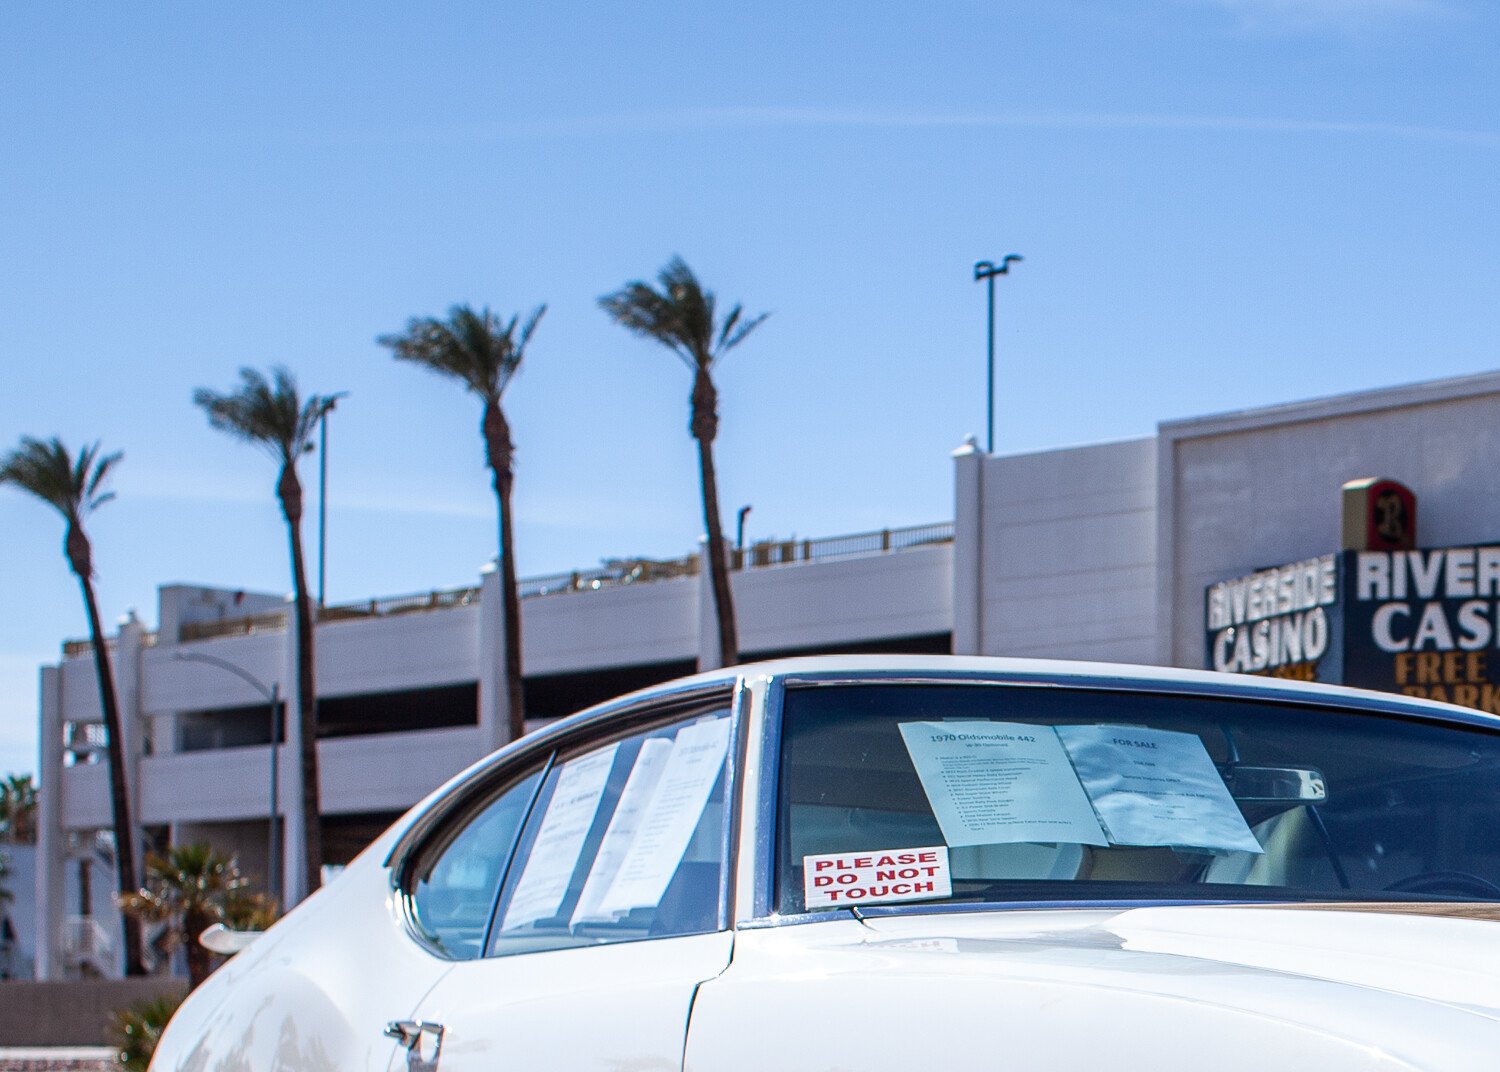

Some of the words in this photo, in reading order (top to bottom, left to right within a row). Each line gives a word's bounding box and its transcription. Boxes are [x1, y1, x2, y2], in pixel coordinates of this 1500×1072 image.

[1208, 553, 1335, 630] RIVERSIDE
[1214, 607, 1327, 672] CASINO
[1395, 652, 1487, 684] FREE
[931, 733, 956, 742] 1970
[957, 732, 1015, 741] Oldsmobile
[1017, 735, 1036, 743] 442
[1113, 738, 1133, 746] FOR
[1136, 740, 1158, 749] SALE
[816, 852, 937, 871] PLEASE
[815, 874, 858, 887] DO
[876, 866, 940, 881] NOT
[824, 881, 933, 900] TOUCH
